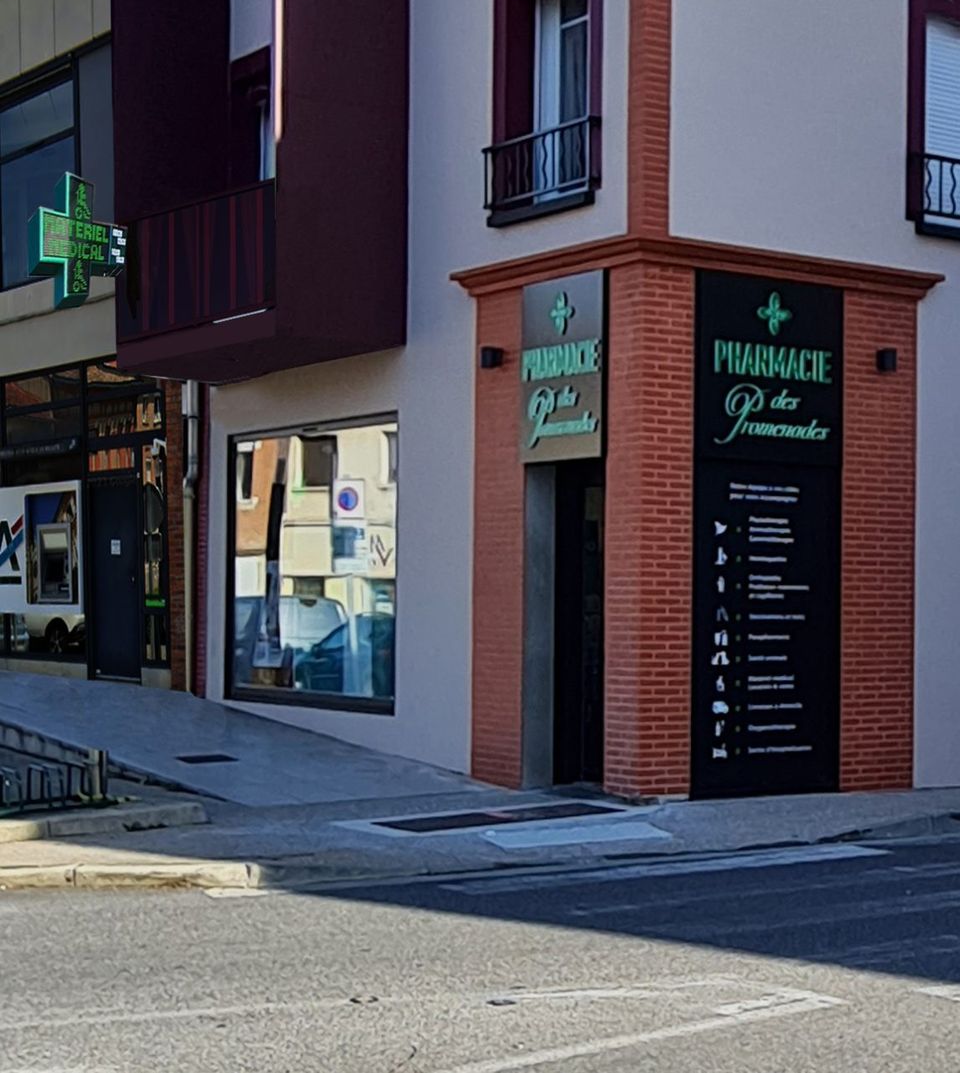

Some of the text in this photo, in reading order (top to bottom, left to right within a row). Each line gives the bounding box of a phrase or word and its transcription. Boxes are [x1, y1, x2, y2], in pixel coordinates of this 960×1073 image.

[713, 338, 833, 385] PHARMACIE
[713, 383, 832, 444] Promenades
[770, 388, 802, 410] des
